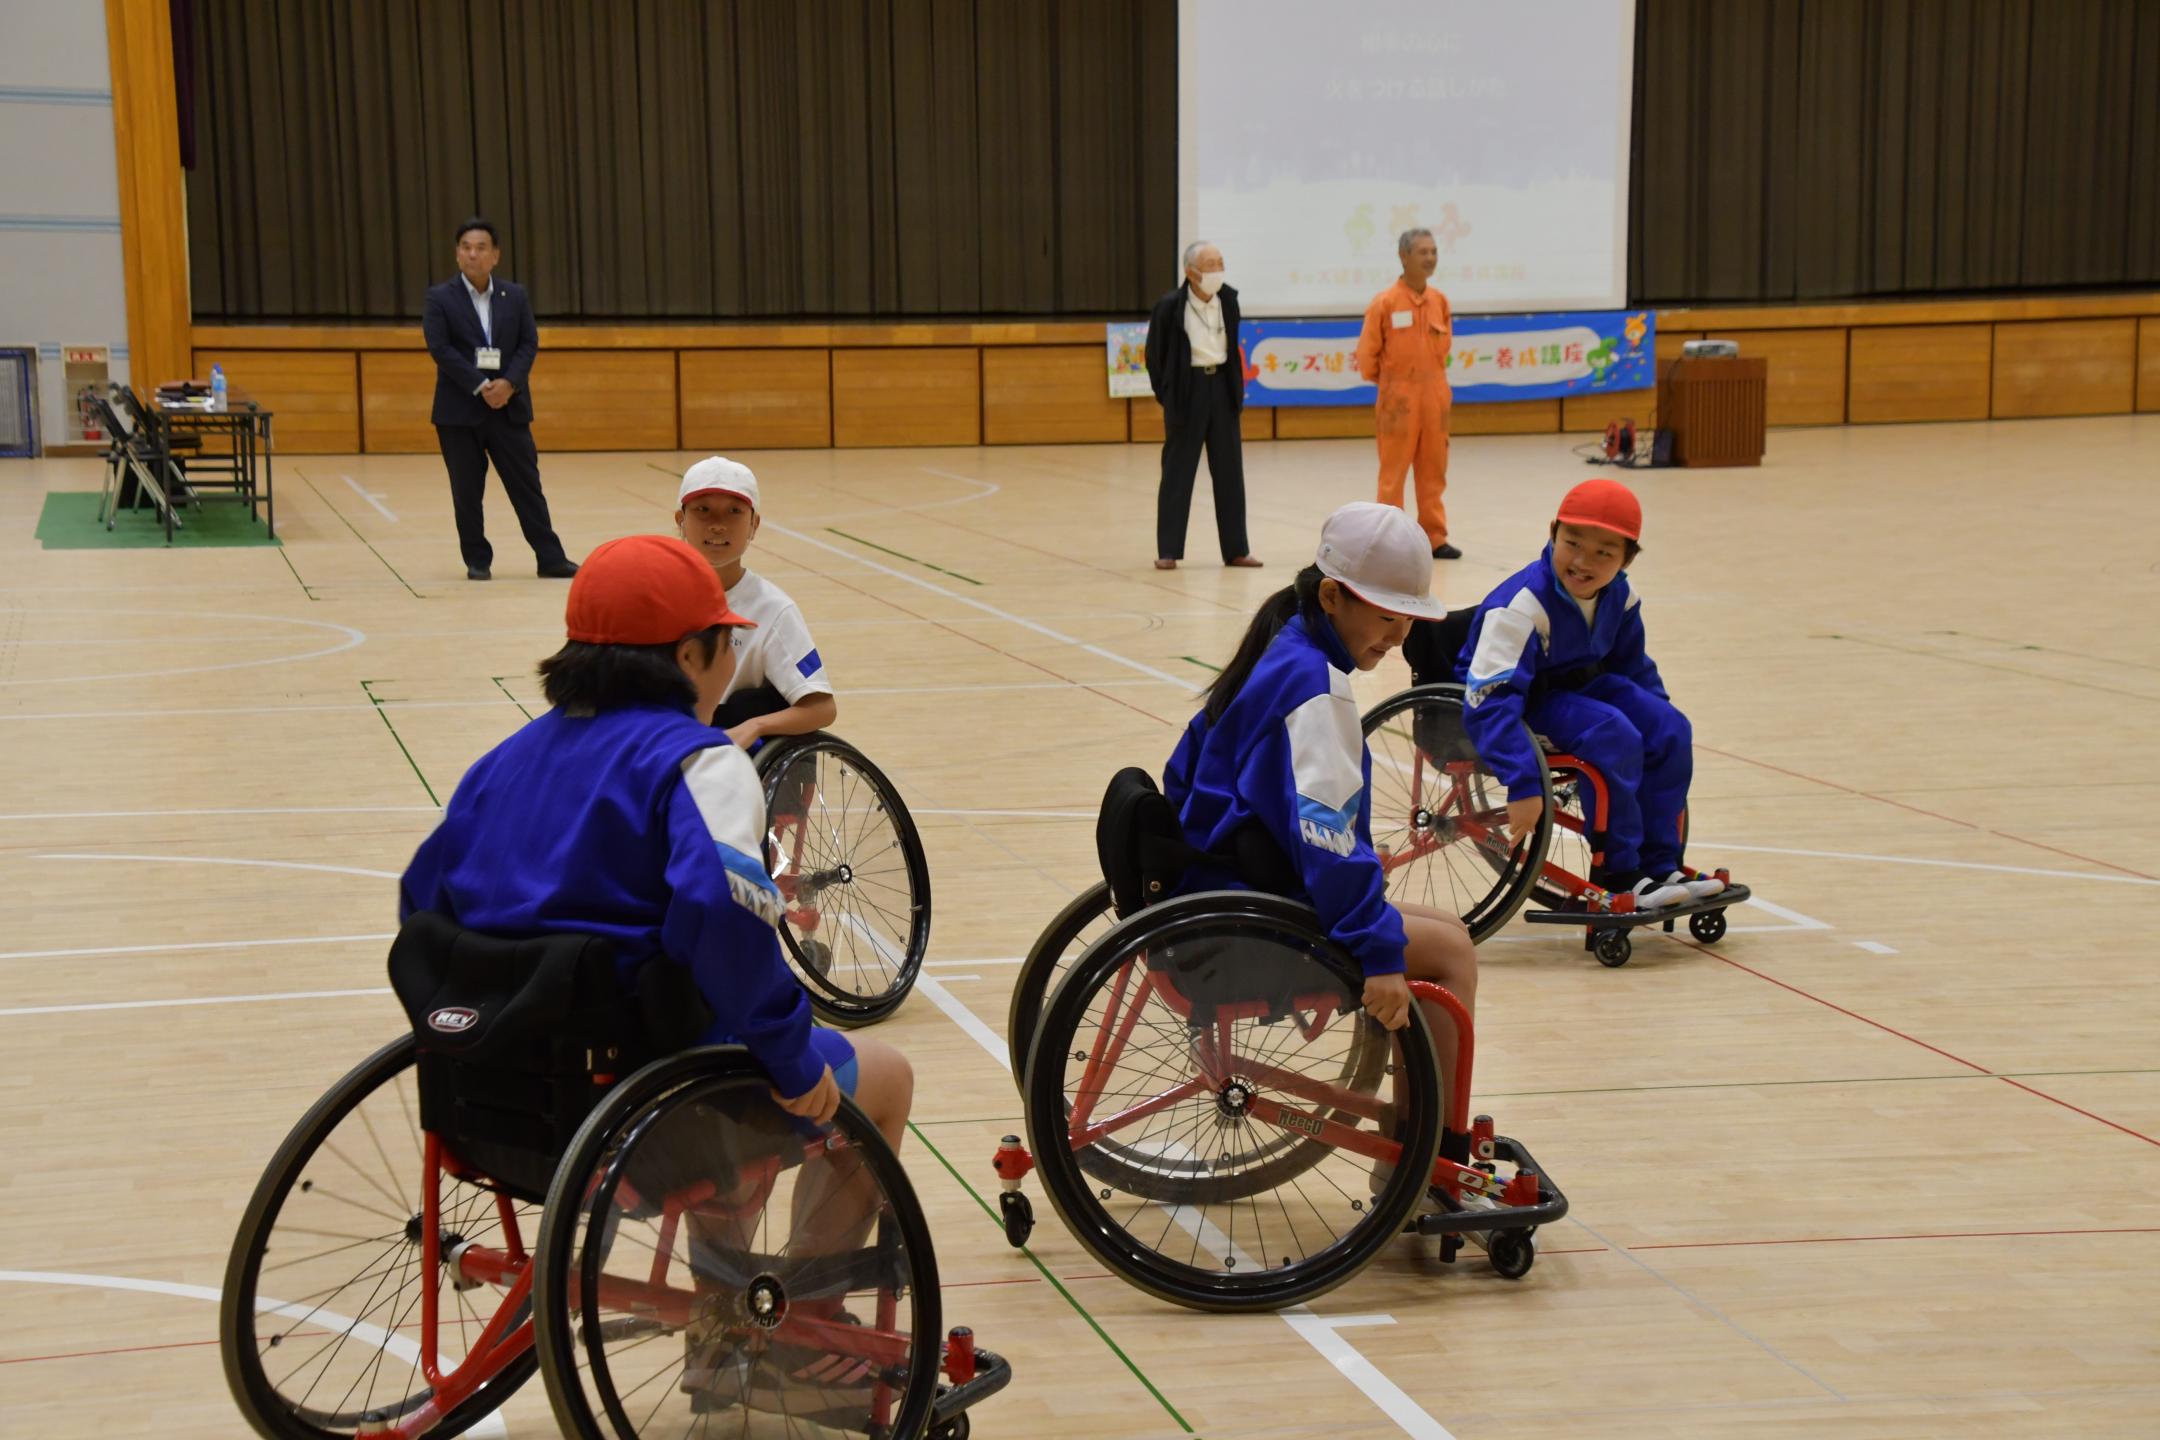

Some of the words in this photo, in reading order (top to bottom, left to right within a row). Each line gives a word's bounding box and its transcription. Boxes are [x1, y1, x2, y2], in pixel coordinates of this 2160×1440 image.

[1446, 342, 1584, 369] ダー養成講座
